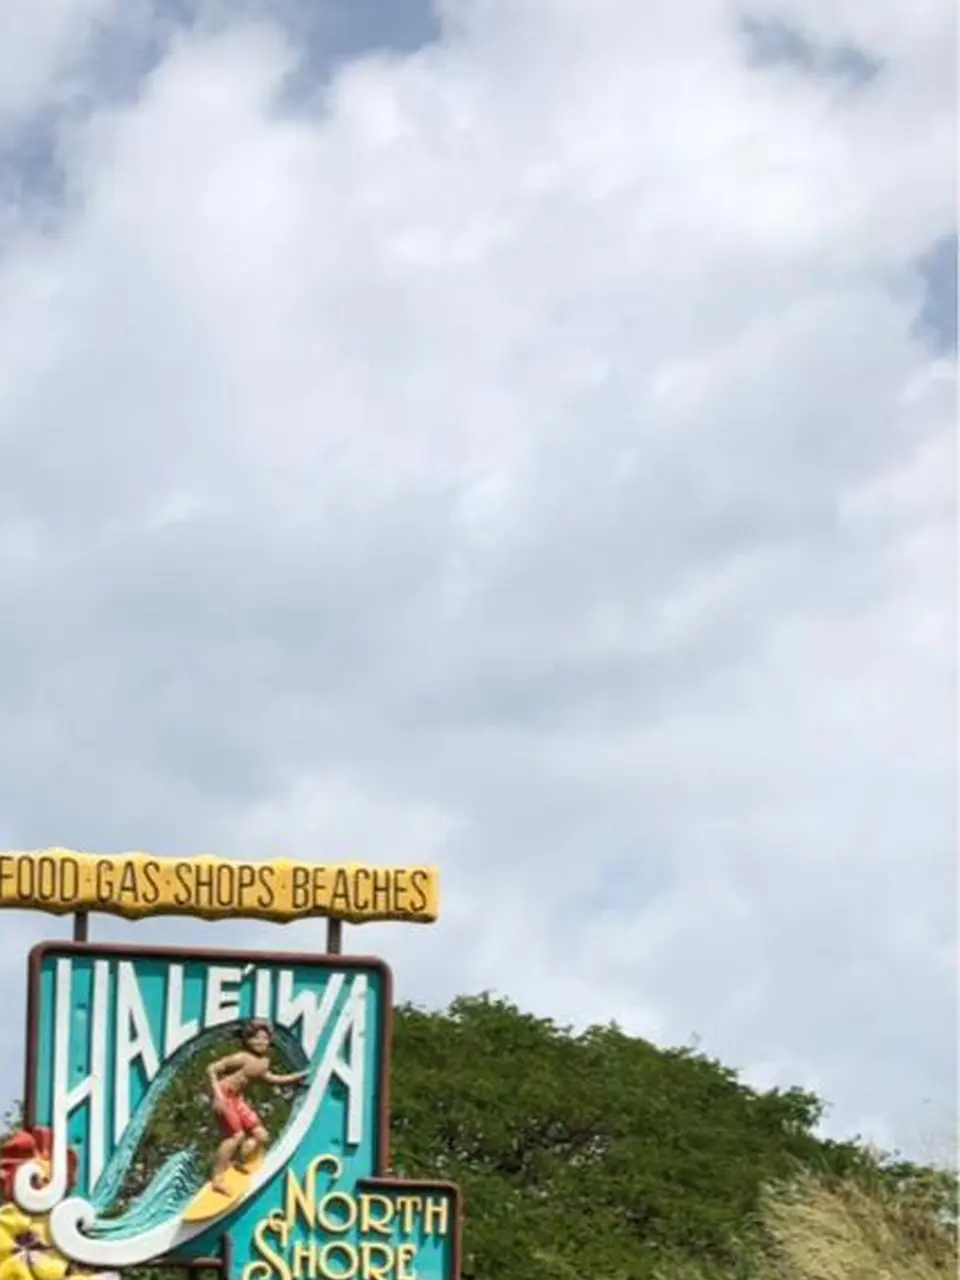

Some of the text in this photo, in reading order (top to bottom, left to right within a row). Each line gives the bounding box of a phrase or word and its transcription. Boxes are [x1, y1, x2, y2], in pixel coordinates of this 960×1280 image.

[96, 859, 160, 904] GAS
[173, 862, 276, 909] SHOPS
[292, 866, 428, 913] BEACHES
[286, 1153, 448, 1235] NORTH
